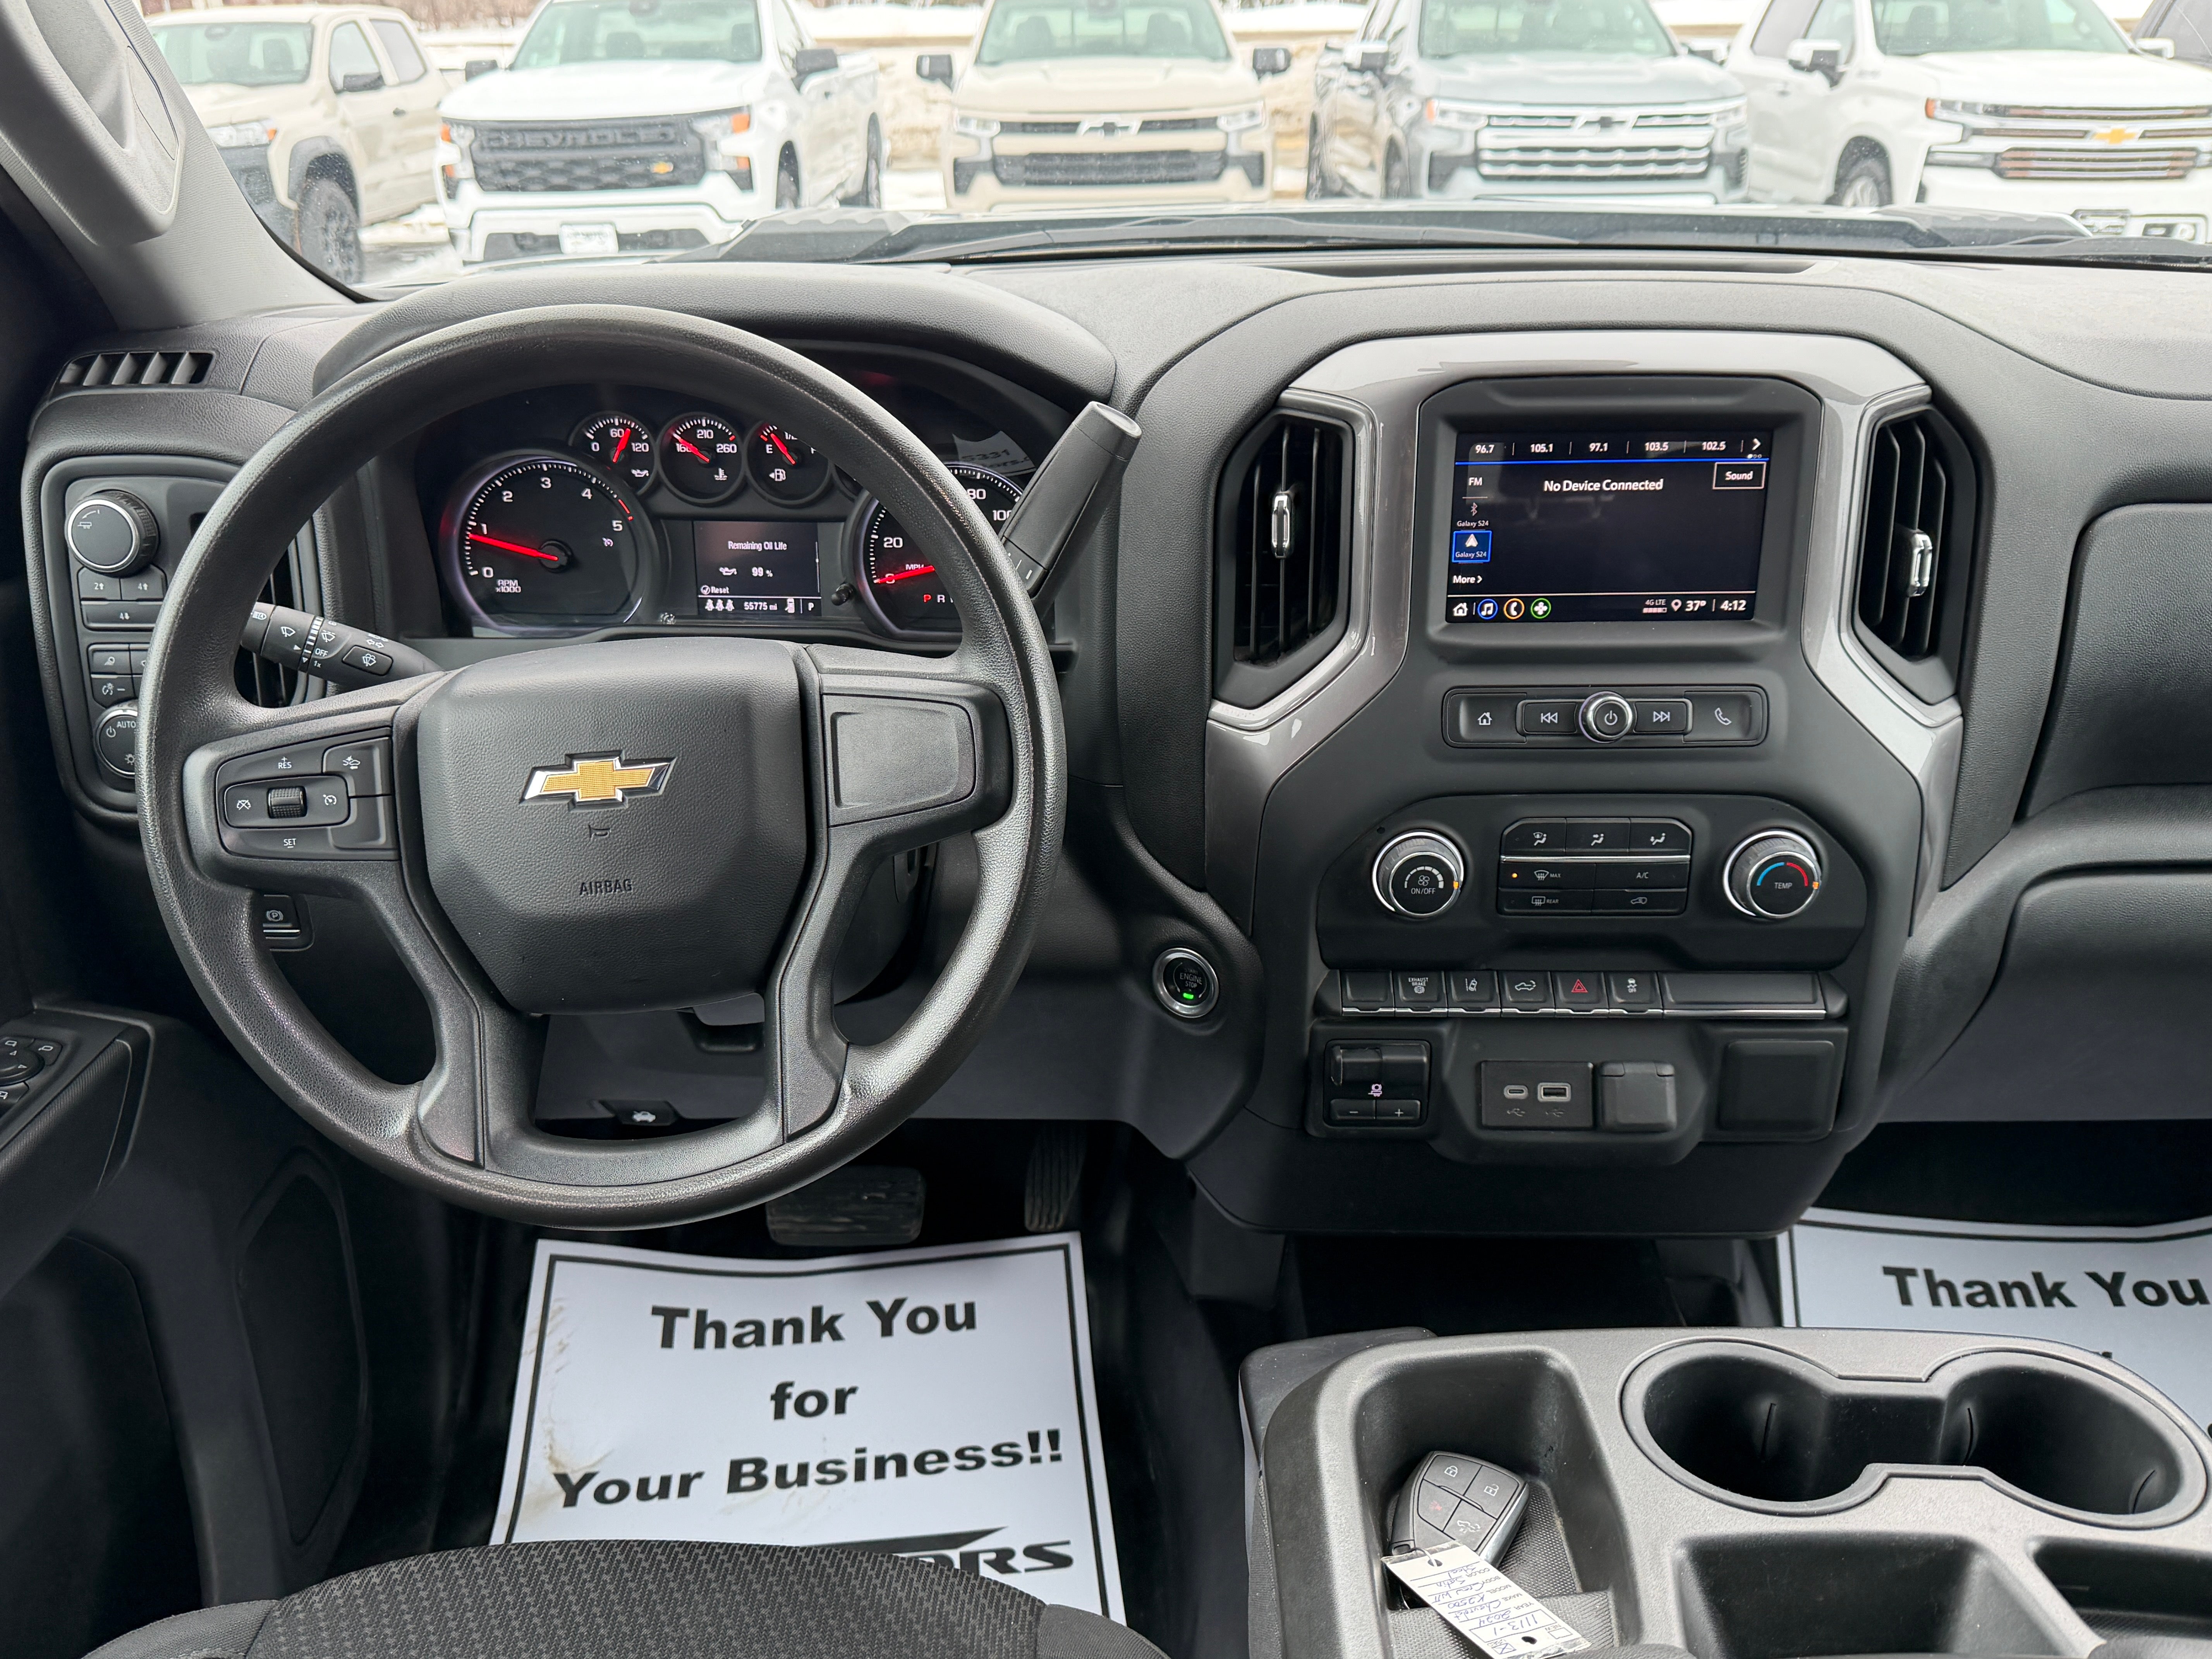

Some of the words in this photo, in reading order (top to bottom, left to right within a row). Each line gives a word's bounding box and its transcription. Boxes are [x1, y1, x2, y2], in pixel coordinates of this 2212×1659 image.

[610, 428, 624, 438] 60
[697, 429, 714, 439] 210
[591, 442, 599, 451] 0
[631, 443, 649, 452] 120
[716, 443, 737, 453] 260
[766, 444, 773, 453] E
[1475, 445, 1495, 453] 96.7
[1530, 443, 1553, 453] 105.1
[1589, 443, 1608, 452] 97.1
[1645, 442, 1669, 451] 103.5
[1702, 441, 1726, 451] 102.5
[1725, 471, 1753, 481] Sound
[541, 477, 551, 488] 3
[1468, 477, 1482, 486] FM
[1544, 480, 1561, 492] No
[1563, 480, 1601, 491] Device
[1602, 479, 1664, 491] Connected
[503, 491, 513, 502] 2
[582, 488, 592, 499] 4
[967, 488, 986, 500] 80
[482, 524, 487, 534] 1
[612, 520, 623, 531] 5
[728, 541, 762, 551] Remaining
[764, 542, 773, 550] Oil
[775, 542, 787, 550] Life
[883, 537, 903, 548] 20
[482, 567, 494, 577] 0
[752, 567, 763, 577] 99
[1453, 575, 1475, 584] More
[923, 594, 931, 603] P
[937, 594, 945, 603] R
[744, 602, 768, 610] 55775
[808, 603, 814, 611] P
[1720, 600, 1747, 611] 4:12
[315, 648, 328, 657] OFF
[1636, 872, 1649, 880] A/C
[579, 879, 632, 896] AIRBAG
[1774, 882, 1792, 890] TEMP
[1180, 973, 1202, 985] ENGINE
[1882, 1266, 2077, 1308] Thank
[2084, 1271, 2211, 1307] You
[651, 1305, 844, 1350] Thank
[866, 1297, 977, 1338] You
[771, 1381, 857, 1420] for
[553, 1468, 705, 1508] Your
[727, 1428, 1063, 1495] Business!!
[1466, 1568, 1490, 1577] COLOR
[1436, 1577, 1465, 1589] Satin
[1456, 1582, 1484, 1594] Crew
[1486, 1584, 1511, 1594] MODEL
[1448, 1594, 1484, 1608] K2500
[1502, 1593, 1522, 1602] MAKE
[1454, 1599, 1501, 1620] Chevrolet
[1513, 1602, 1534, 1610] YEAR
[1479, 1610, 1511, 1626] 2024
